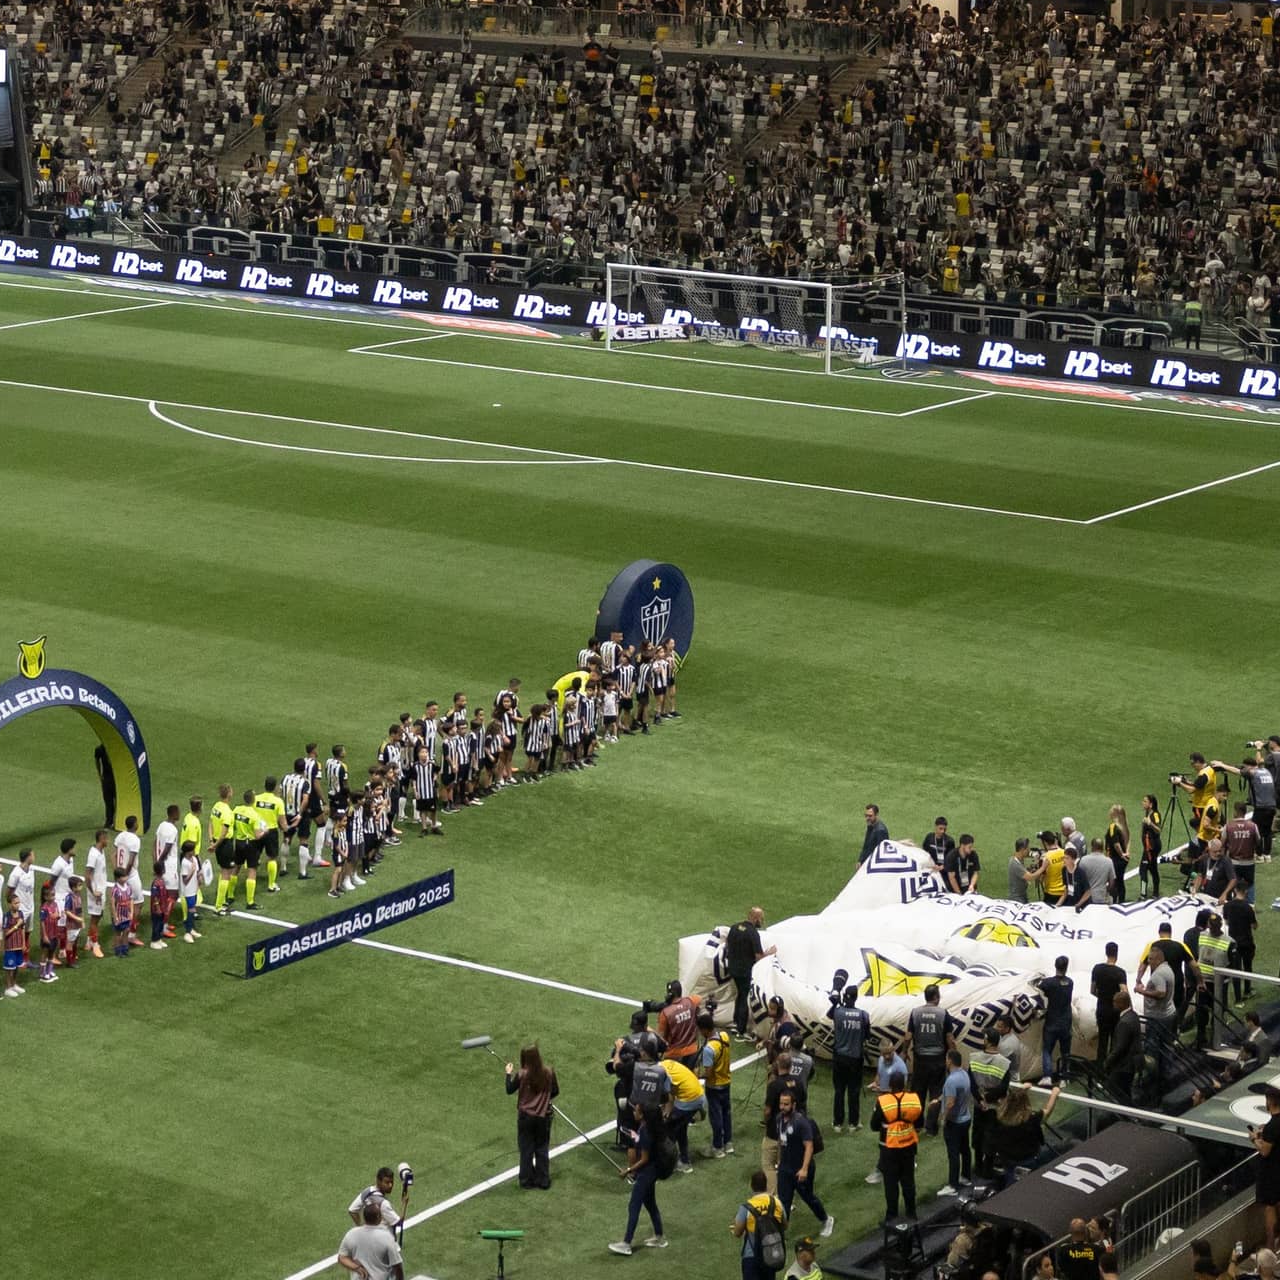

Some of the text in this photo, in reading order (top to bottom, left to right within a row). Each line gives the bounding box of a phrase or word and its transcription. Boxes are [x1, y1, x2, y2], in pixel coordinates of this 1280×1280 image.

[50, 245, 100, 268] H2bet
[112, 252, 163, 275] H2bet
[175, 259, 226, 282] H2bet
[239, 266, 292, 290] H2bet
[306, 274, 359, 298] H2bet
[373, 280, 428, 305] H2bet
[442, 287, 499, 312] H2bet
[514, 294, 571, 319] H2bet
[896, 334, 961, 362] H2bet
[979, 341, 1046, 369] H2bet
[1064, 350, 1132, 378] H2bet
[1150, 359, 1220, 387] H2bet
[644, 602, 668, 617] CAM
[78, 687, 116, 721] Betano
[269, 882, 451, 964] BRASILEIRÃO Betano 2025
